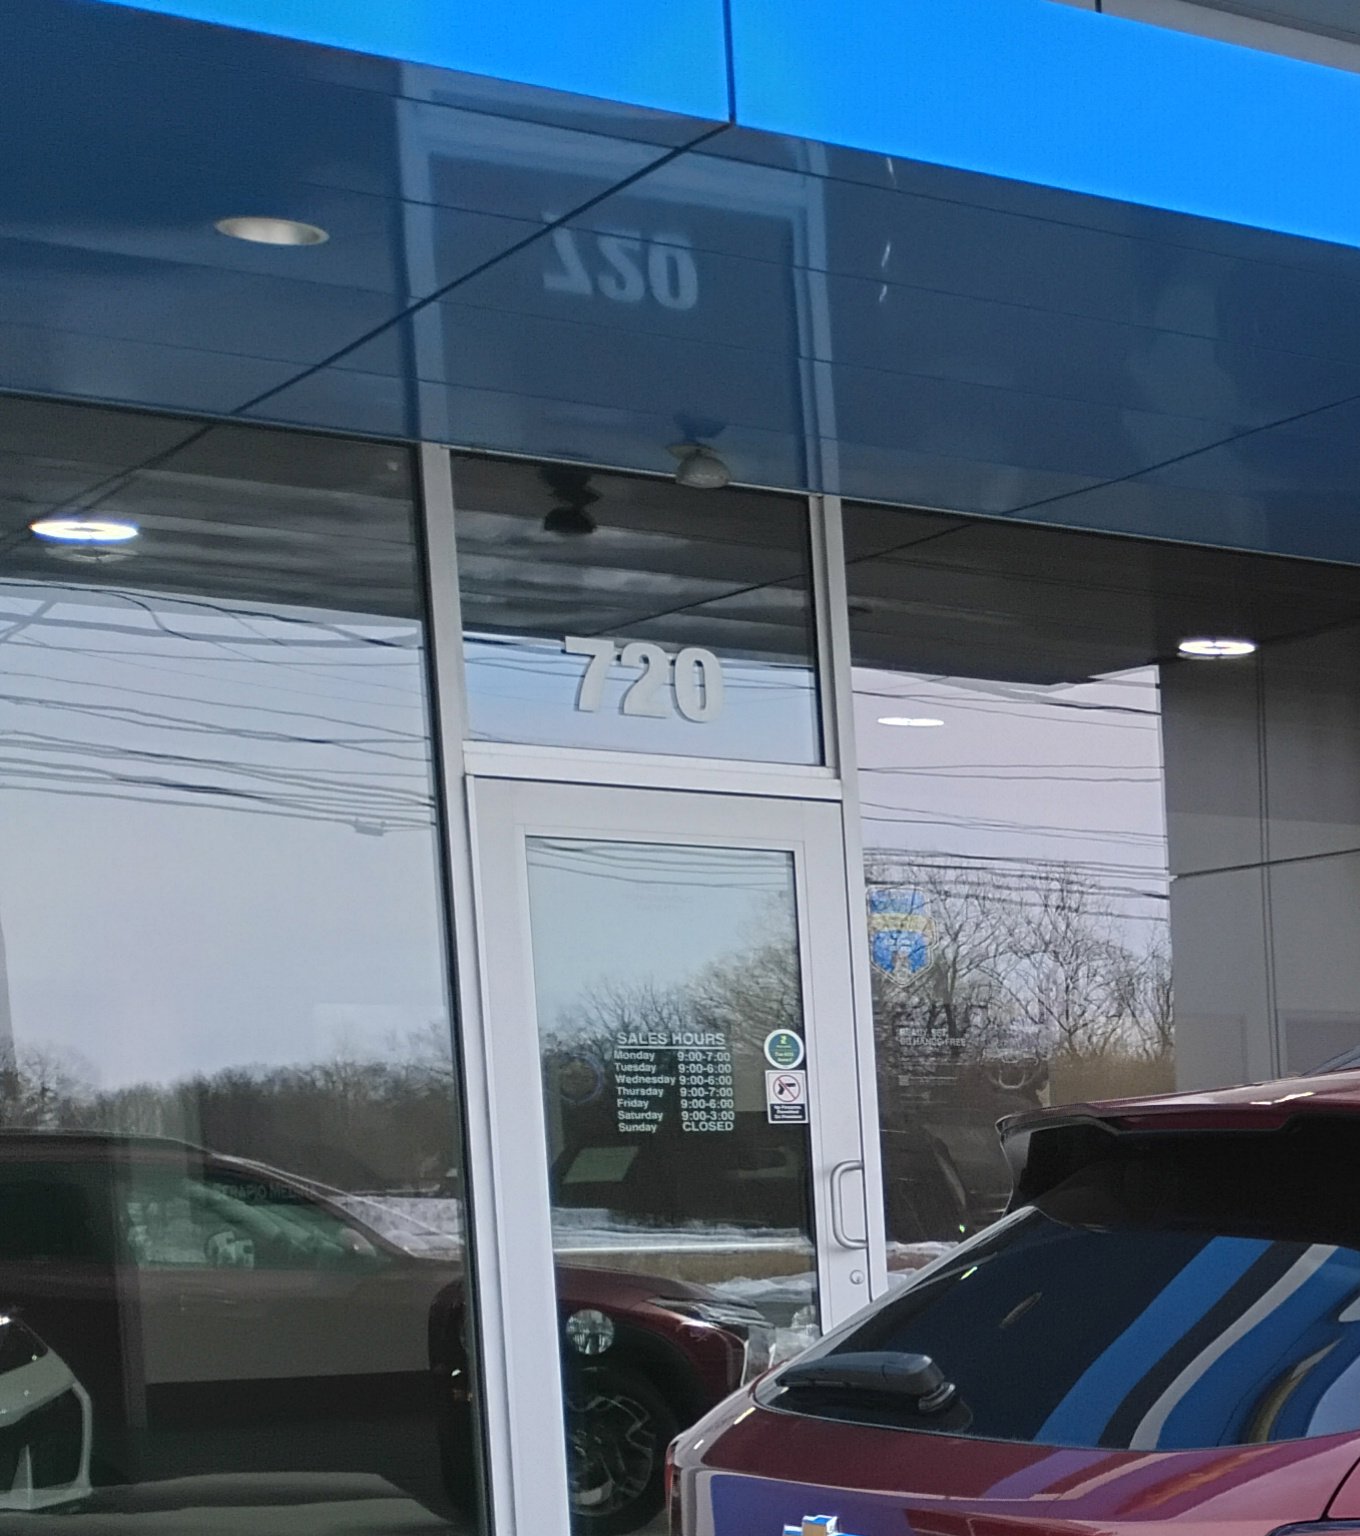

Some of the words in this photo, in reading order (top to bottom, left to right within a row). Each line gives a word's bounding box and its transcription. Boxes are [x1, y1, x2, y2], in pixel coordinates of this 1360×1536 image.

[564, 636, 724, 724] 720
[616, 1032, 668, 1045] SALES
[671, 1033, 726, 1046] HOURS
[613, 1051, 656, 1061] Monday
[677, 1051, 731, 1062] 9:00-7:00
[614, 1063, 657, 1073] Tuesday
[678, 1063, 732, 1073] 9:00-6:00
[615, 1075, 676, 1086] Wednesday
[679, 1075, 733, 1085] 9:00-6:00
[616, 1086, 664, 1097] Thursday
[679, 1087, 733, 1097] 9:00-7:00
[617, 1098, 649, 1110] Friday
[680, 1099, 734, 1109] 9:00-6:00
[617, 1110, 664, 1122] Saturday
[681, 1111, 735, 1121] 9:00-3:00
[618, 1122, 658, 1133] Sunday
[682, 1121, 734, 1132] CLOSED
